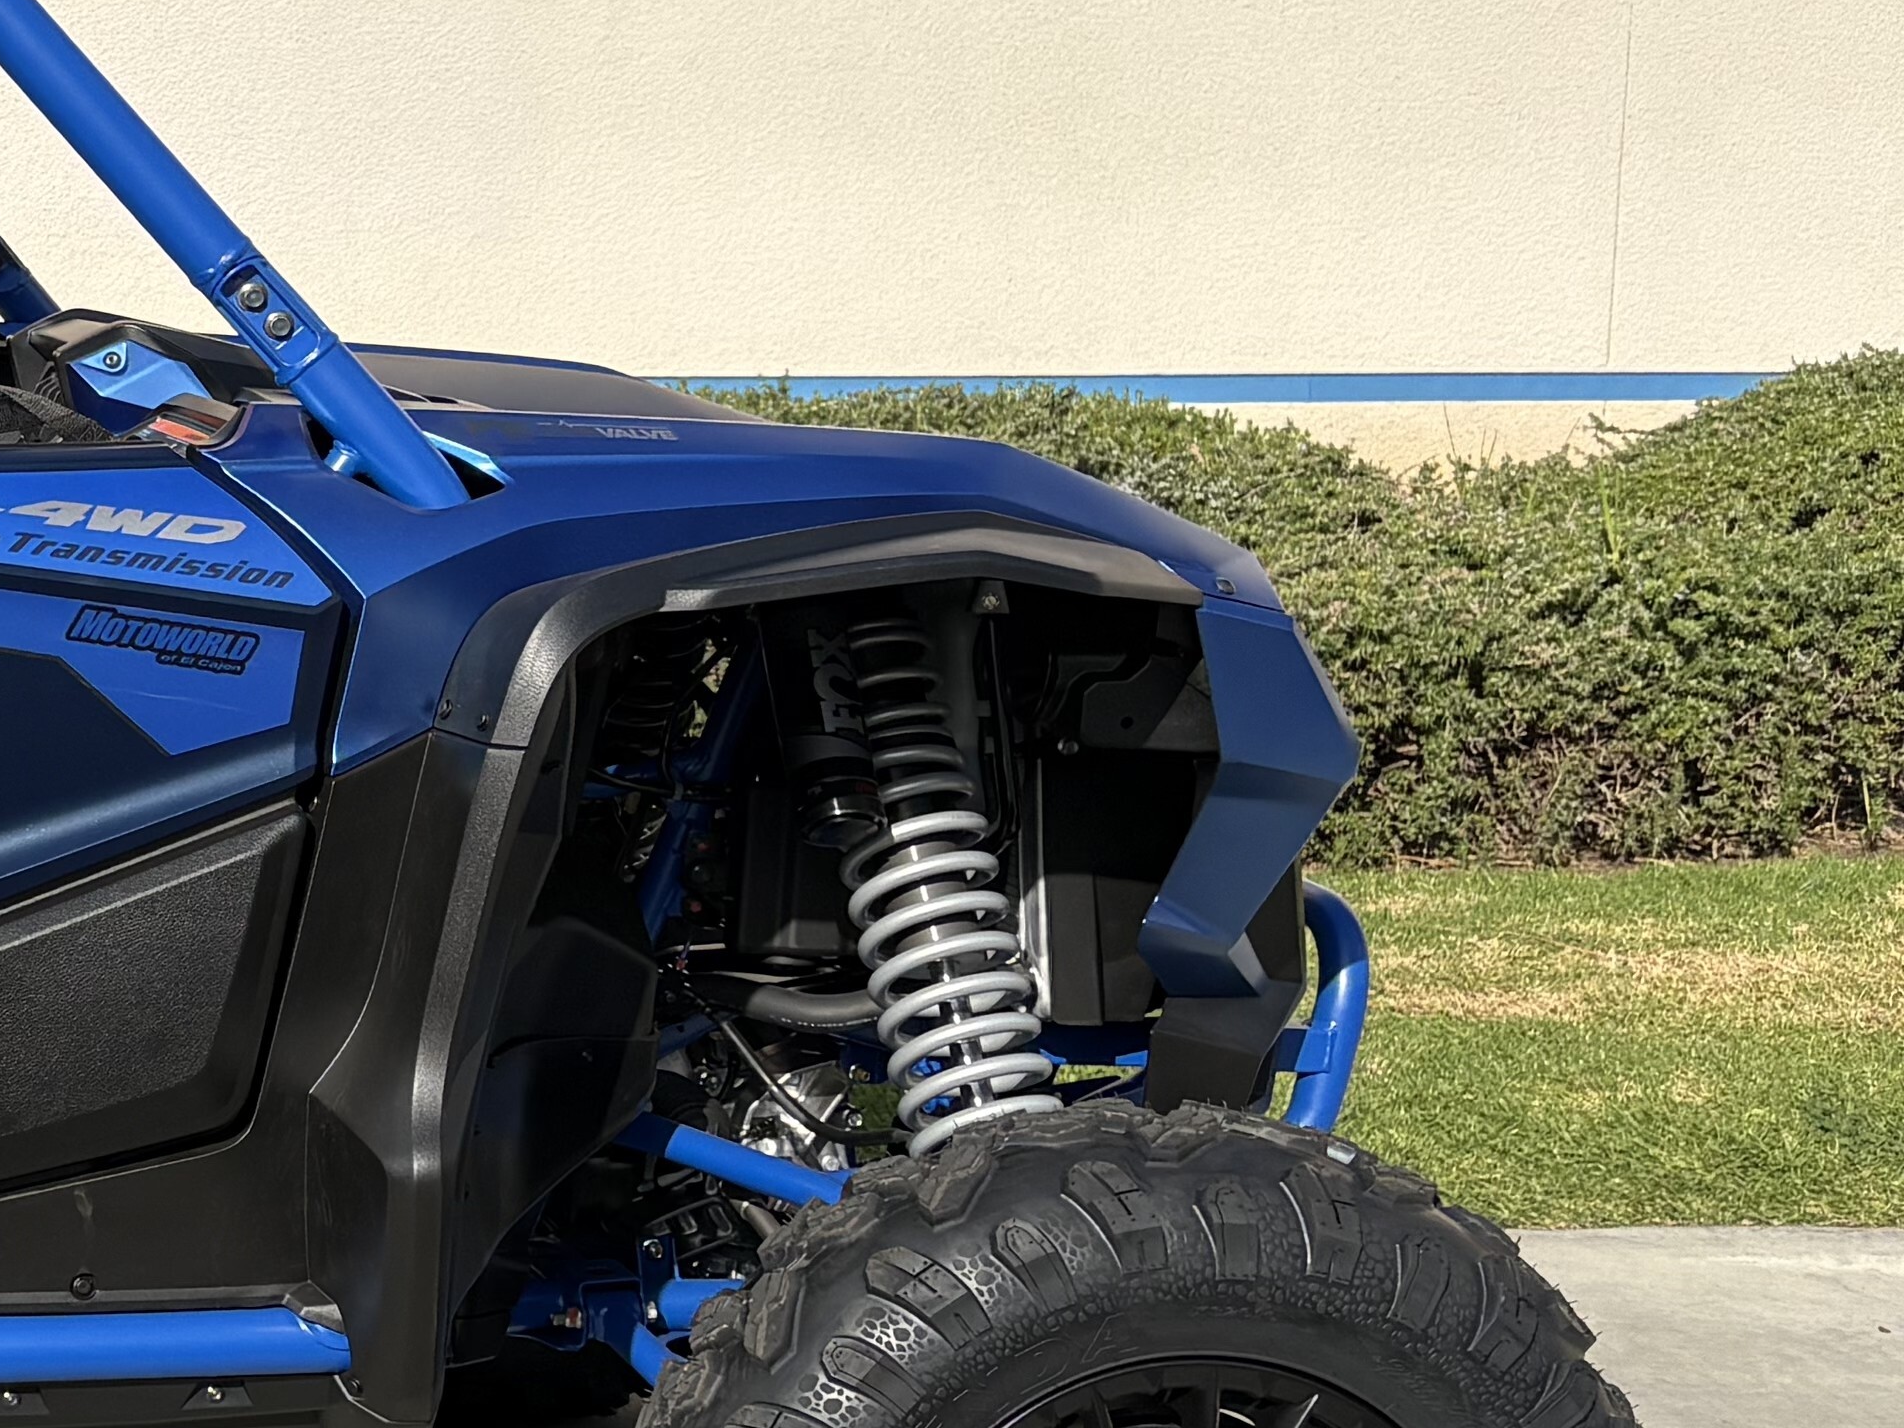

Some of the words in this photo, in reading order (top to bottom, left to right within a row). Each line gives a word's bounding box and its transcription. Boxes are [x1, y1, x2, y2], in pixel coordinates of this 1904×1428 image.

[7, 532, 295, 589] Transmission
[69, 609, 257, 661] MOTOWORLD
[198, 658, 243, 672] Cajon
